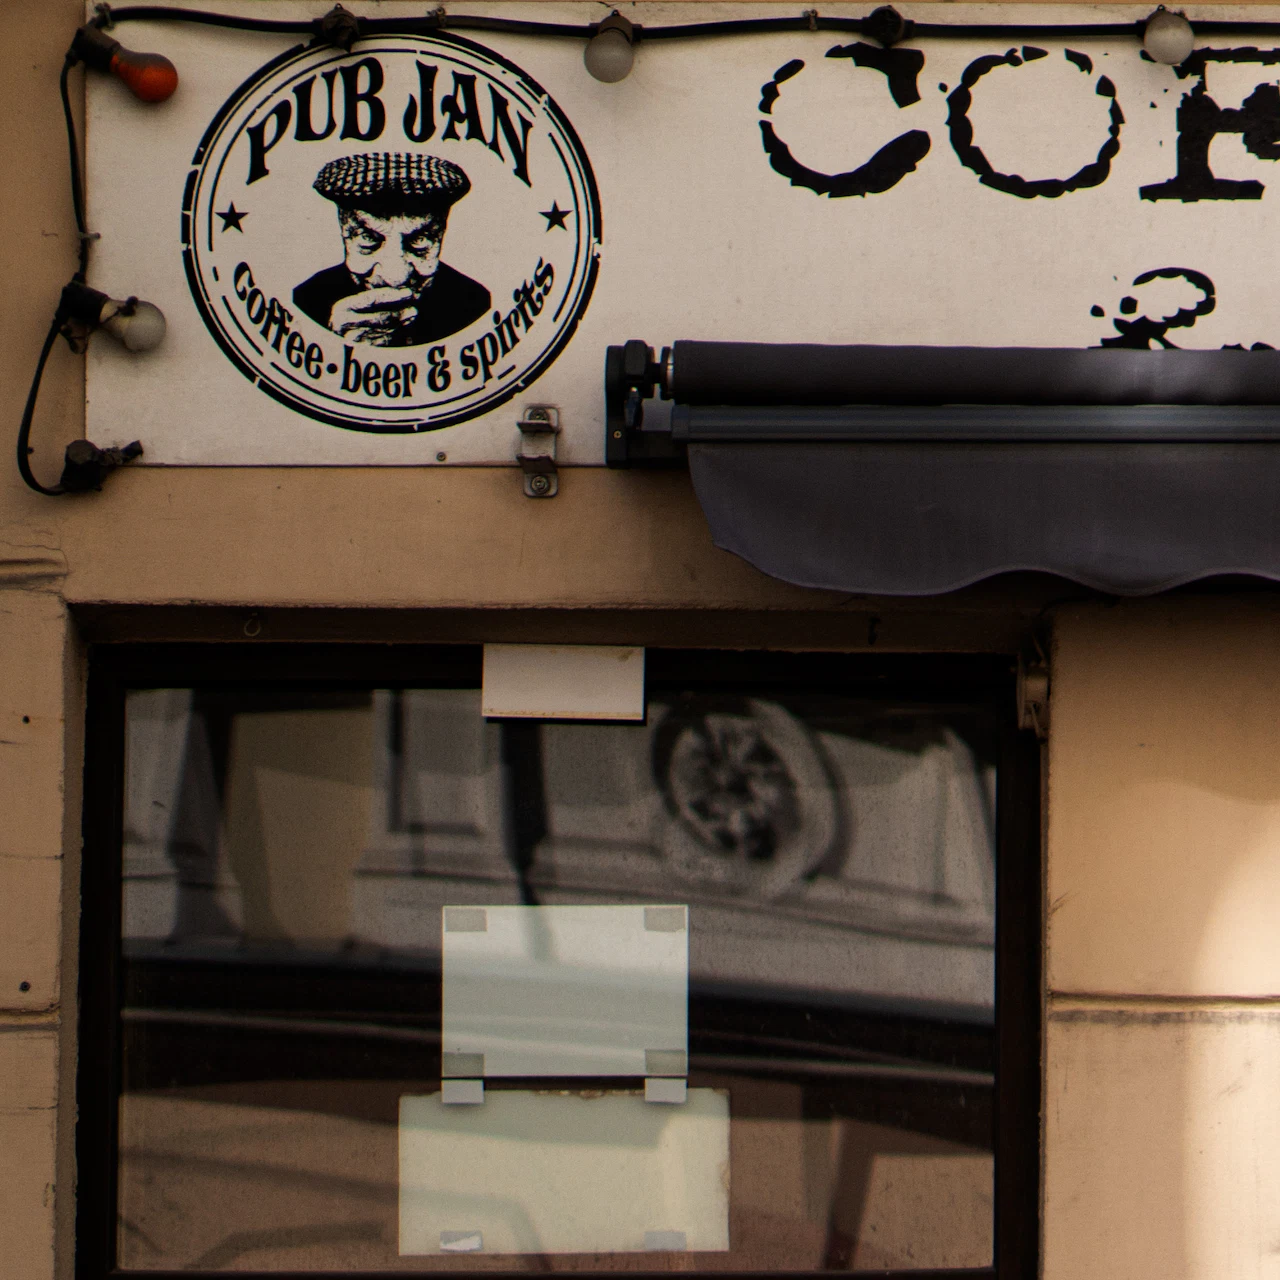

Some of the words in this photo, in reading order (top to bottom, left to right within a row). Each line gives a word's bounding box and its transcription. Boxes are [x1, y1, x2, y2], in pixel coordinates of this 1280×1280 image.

[245, 56, 387, 187] PUB
[402, 60, 535, 188] JAN
[231, 260, 325, 376] coffee
[340, 345, 418, 399] beer
[426, 345, 453, 393] &
[460, 255, 556, 384] spirits
